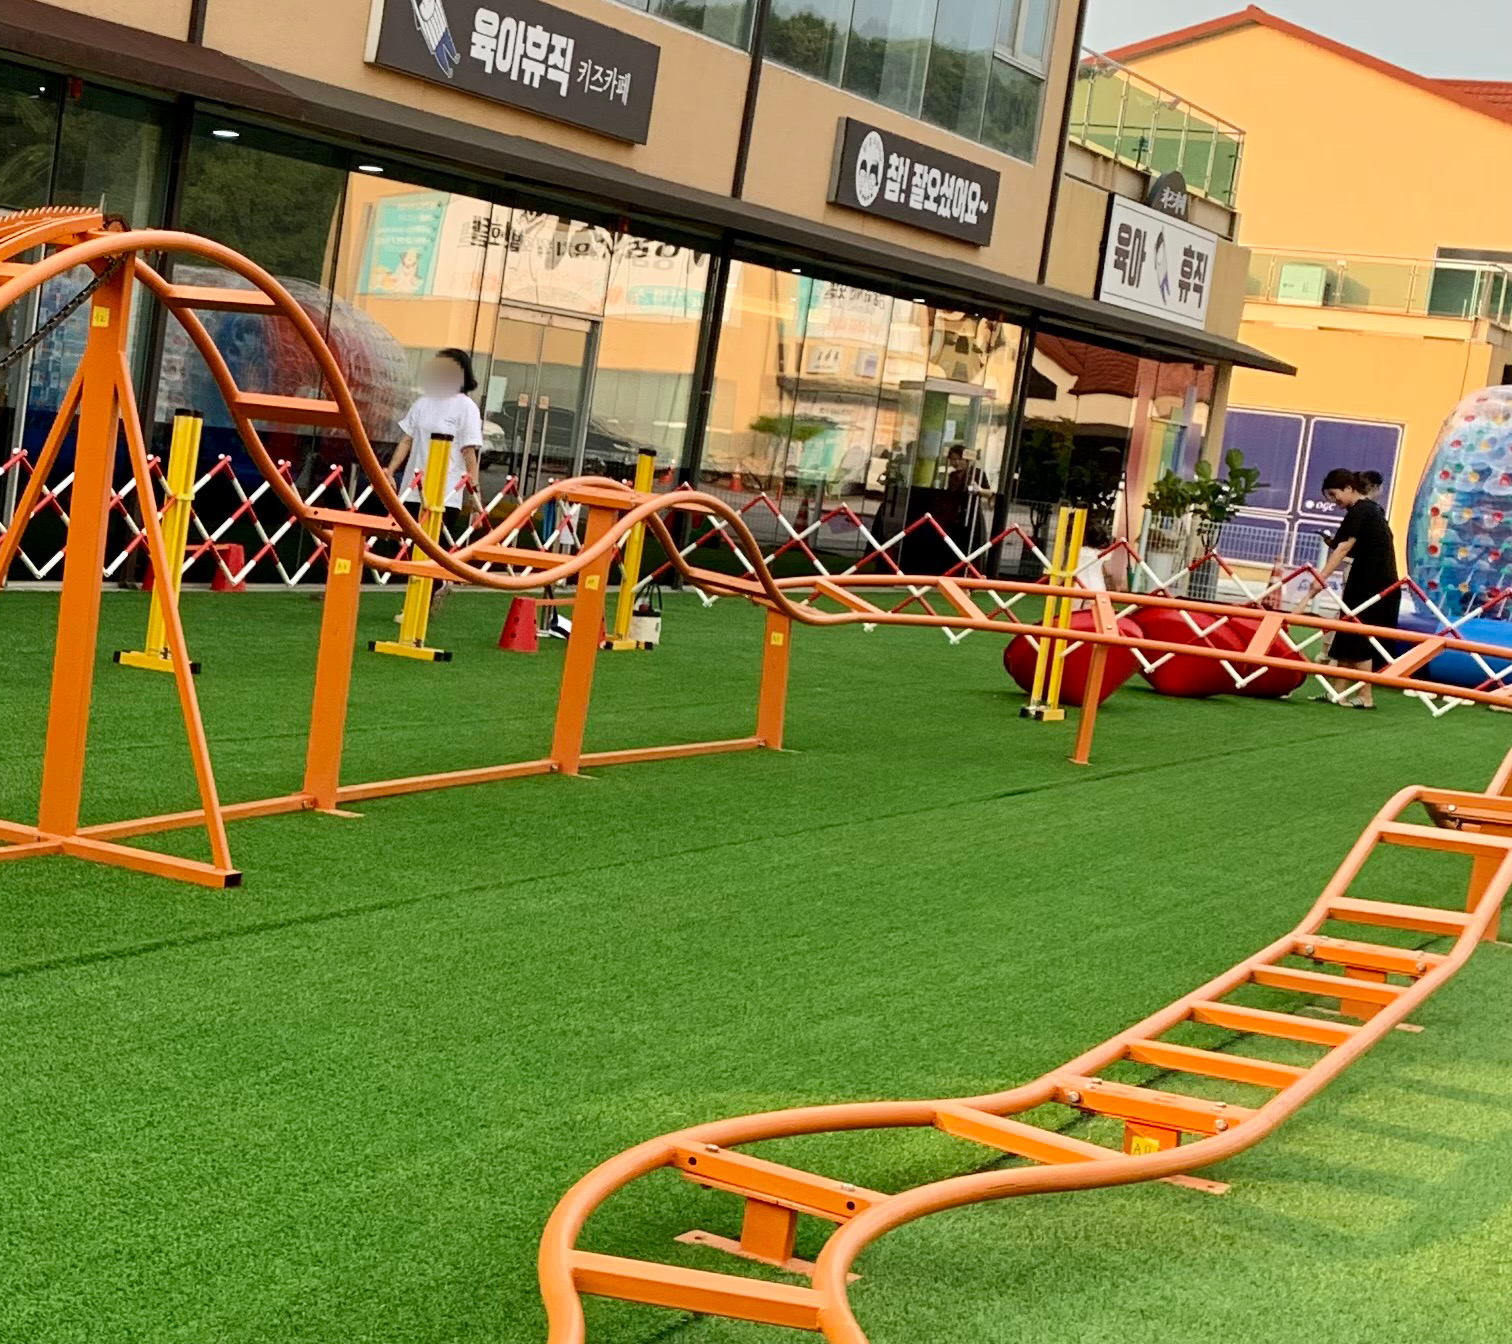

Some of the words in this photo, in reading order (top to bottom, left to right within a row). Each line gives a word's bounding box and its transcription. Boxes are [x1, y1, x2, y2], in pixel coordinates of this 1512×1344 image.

[470, 7, 575, 97] 육아휴직
[577, 59, 631, 106] 키즈카페
[1113, 223, 1147, 288] 육아
[1178, 245, 1208, 308] 휴직
